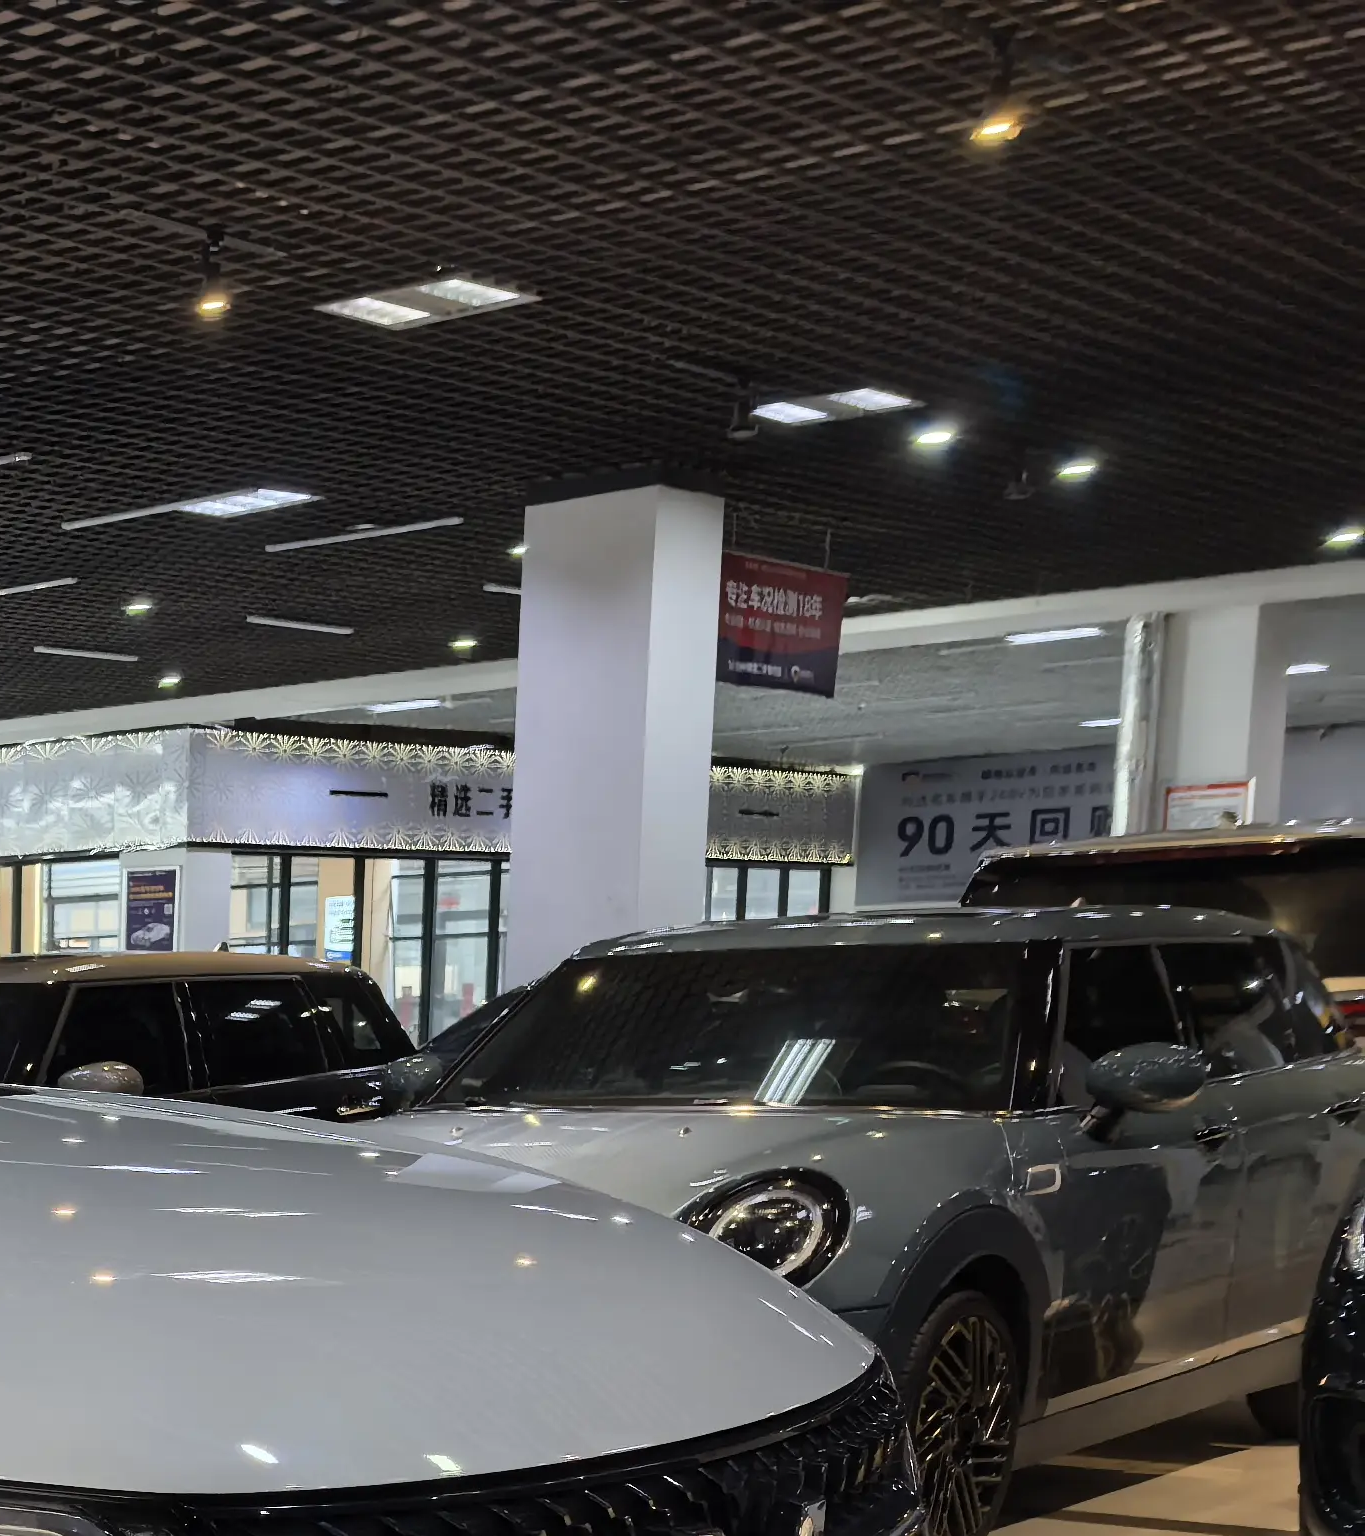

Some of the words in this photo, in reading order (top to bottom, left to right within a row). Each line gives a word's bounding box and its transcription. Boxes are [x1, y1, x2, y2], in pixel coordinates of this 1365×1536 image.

[725, 579, 823, 620] 专注车况检测18年
